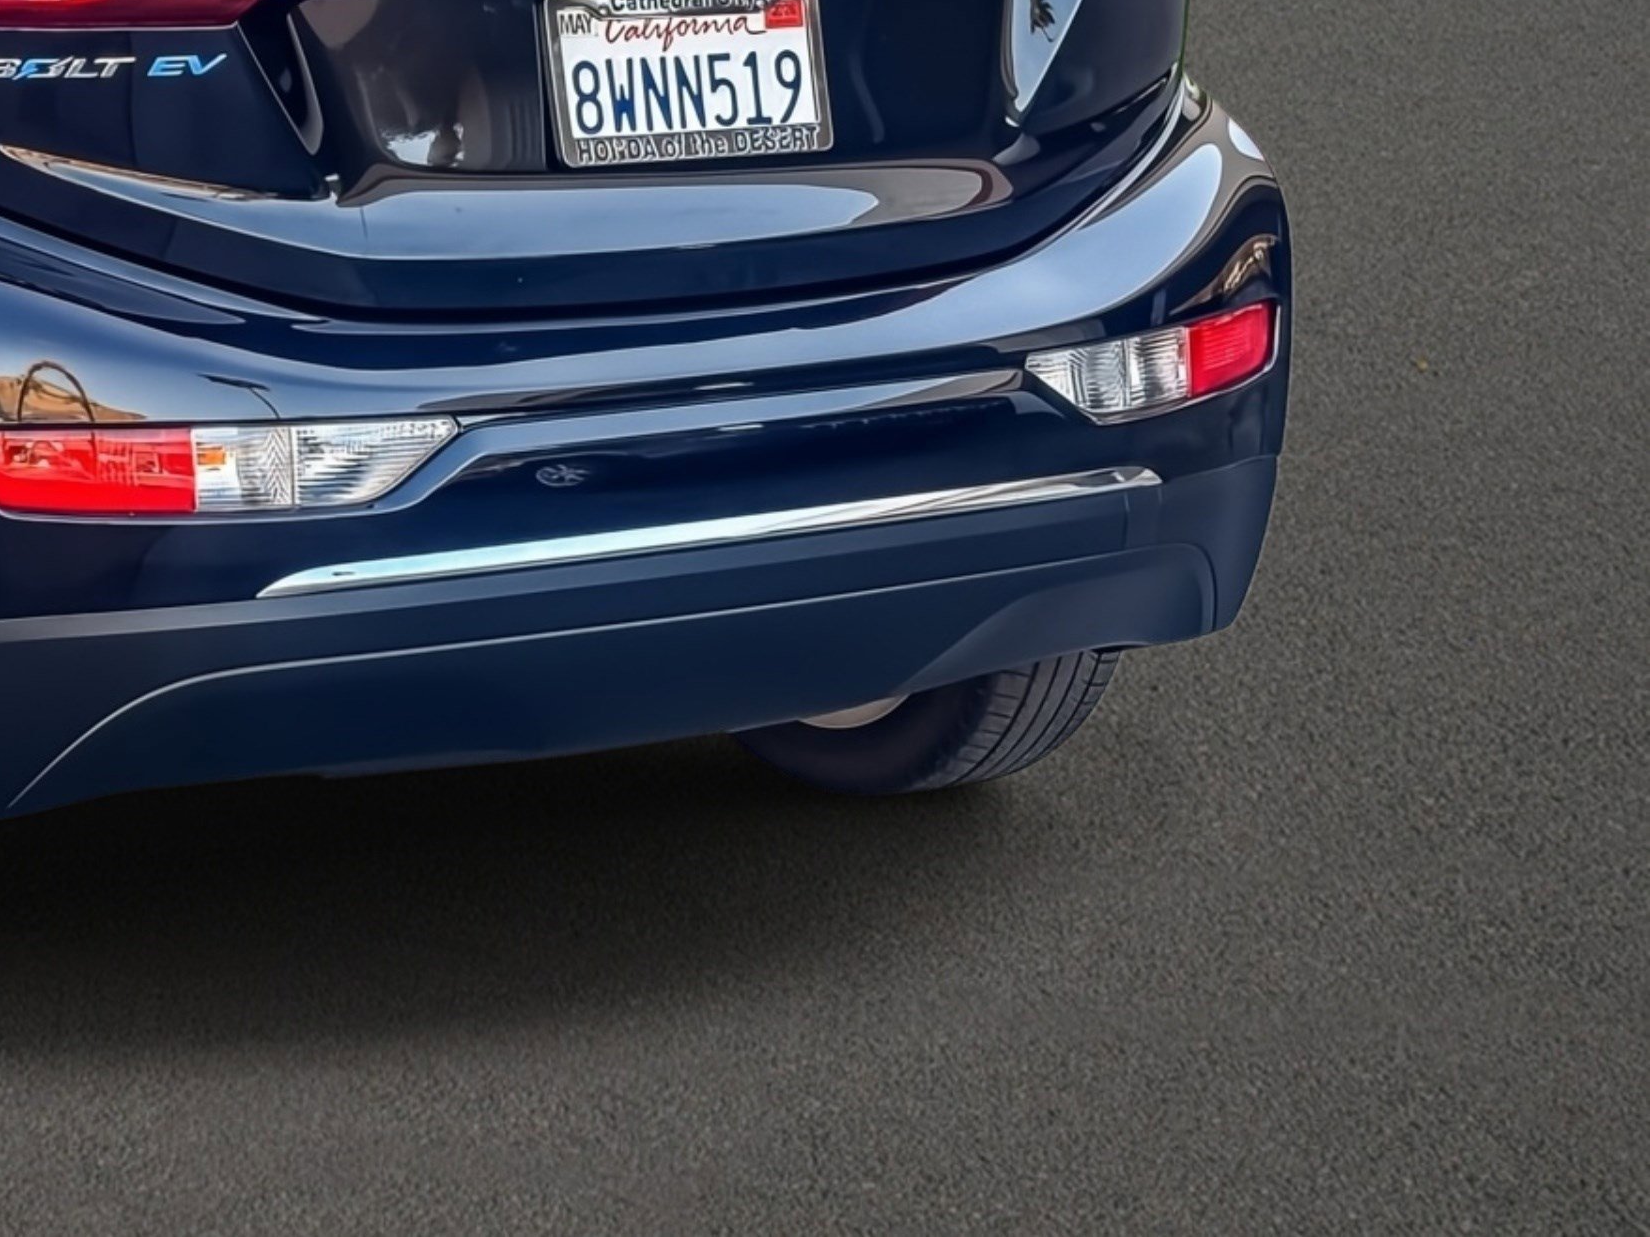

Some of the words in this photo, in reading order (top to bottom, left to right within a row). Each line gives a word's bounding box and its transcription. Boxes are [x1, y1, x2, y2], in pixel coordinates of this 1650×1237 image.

[560, 12, 593, 35] MAY
[604, 14, 766, 52] California
[147, 53, 227, 77] EV
[571, 48, 803, 135] 8WNN519
[577, 136, 658, 162] HONDA
[690, 131, 728, 156] the
[735, 125, 821, 152] DESERT
